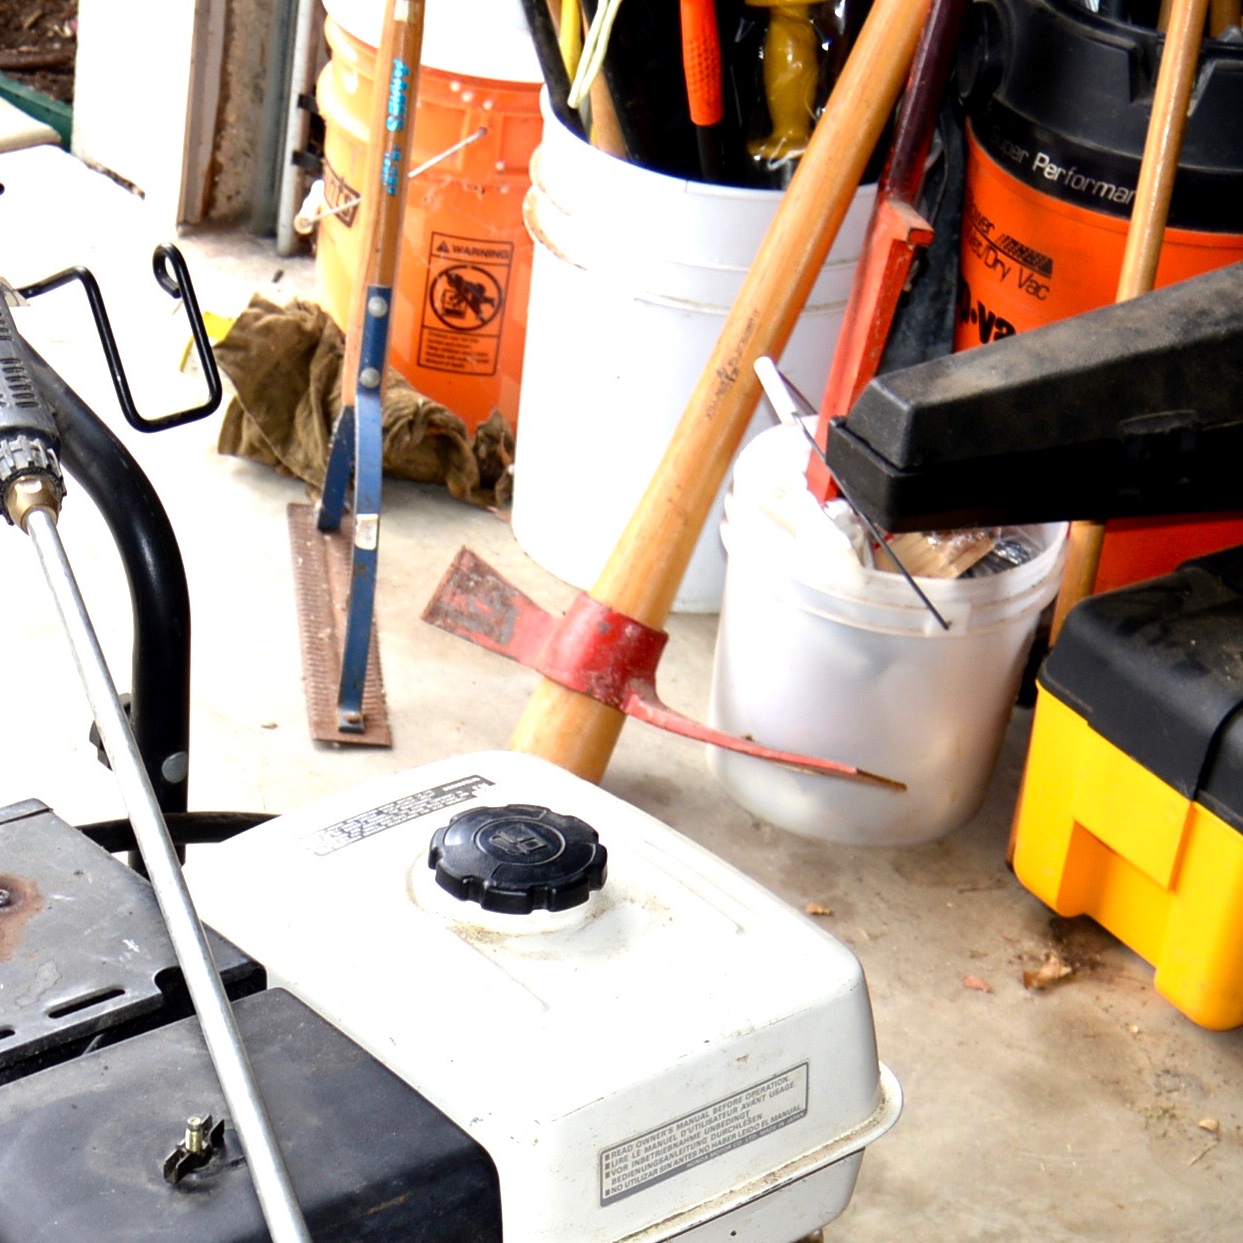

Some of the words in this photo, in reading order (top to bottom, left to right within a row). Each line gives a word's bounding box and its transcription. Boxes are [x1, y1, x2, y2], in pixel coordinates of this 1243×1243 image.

[452, 244, 510, 259] WARNING
[1018, 267, 1051, 300] Vac
[611, 1144, 633, 1158] READ
[635, 1126, 674, 1148] OWNER'S
[675, 1110, 710, 1131] MANUAL
[712, 1095, 743, 1115] BEFORE
[611, 1155, 629, 1168] LIRE
[632, 1149, 642, 1159] LE
[644, 1134, 678, 1154] MANUEL
[680, 1107, 738, 1137] D'UTILISATEUR
[740, 1094, 767, 1111] AVANT
[611, 1164, 629, 1176] VOR
[631, 1131, 702, 1168] INBETRIEBNAHME
[703, 1109, 750, 1135] UNBEDINGT
[611, 1183, 624, 1194] NO
[624, 1168, 659, 1188] UTILIZAR
[659, 1161, 673, 1174] SIN
[672, 1149, 698, 1166] ANTES
[698, 1144, 710, 1156] NO
[711, 1132, 738, 1149] HABER
[737, 1124, 760, 1138] LEIDO
[761, 1119, 770, 1128] EL
[611, 1137, 708, 1185] BEDIENUNGSANLEITUNG
